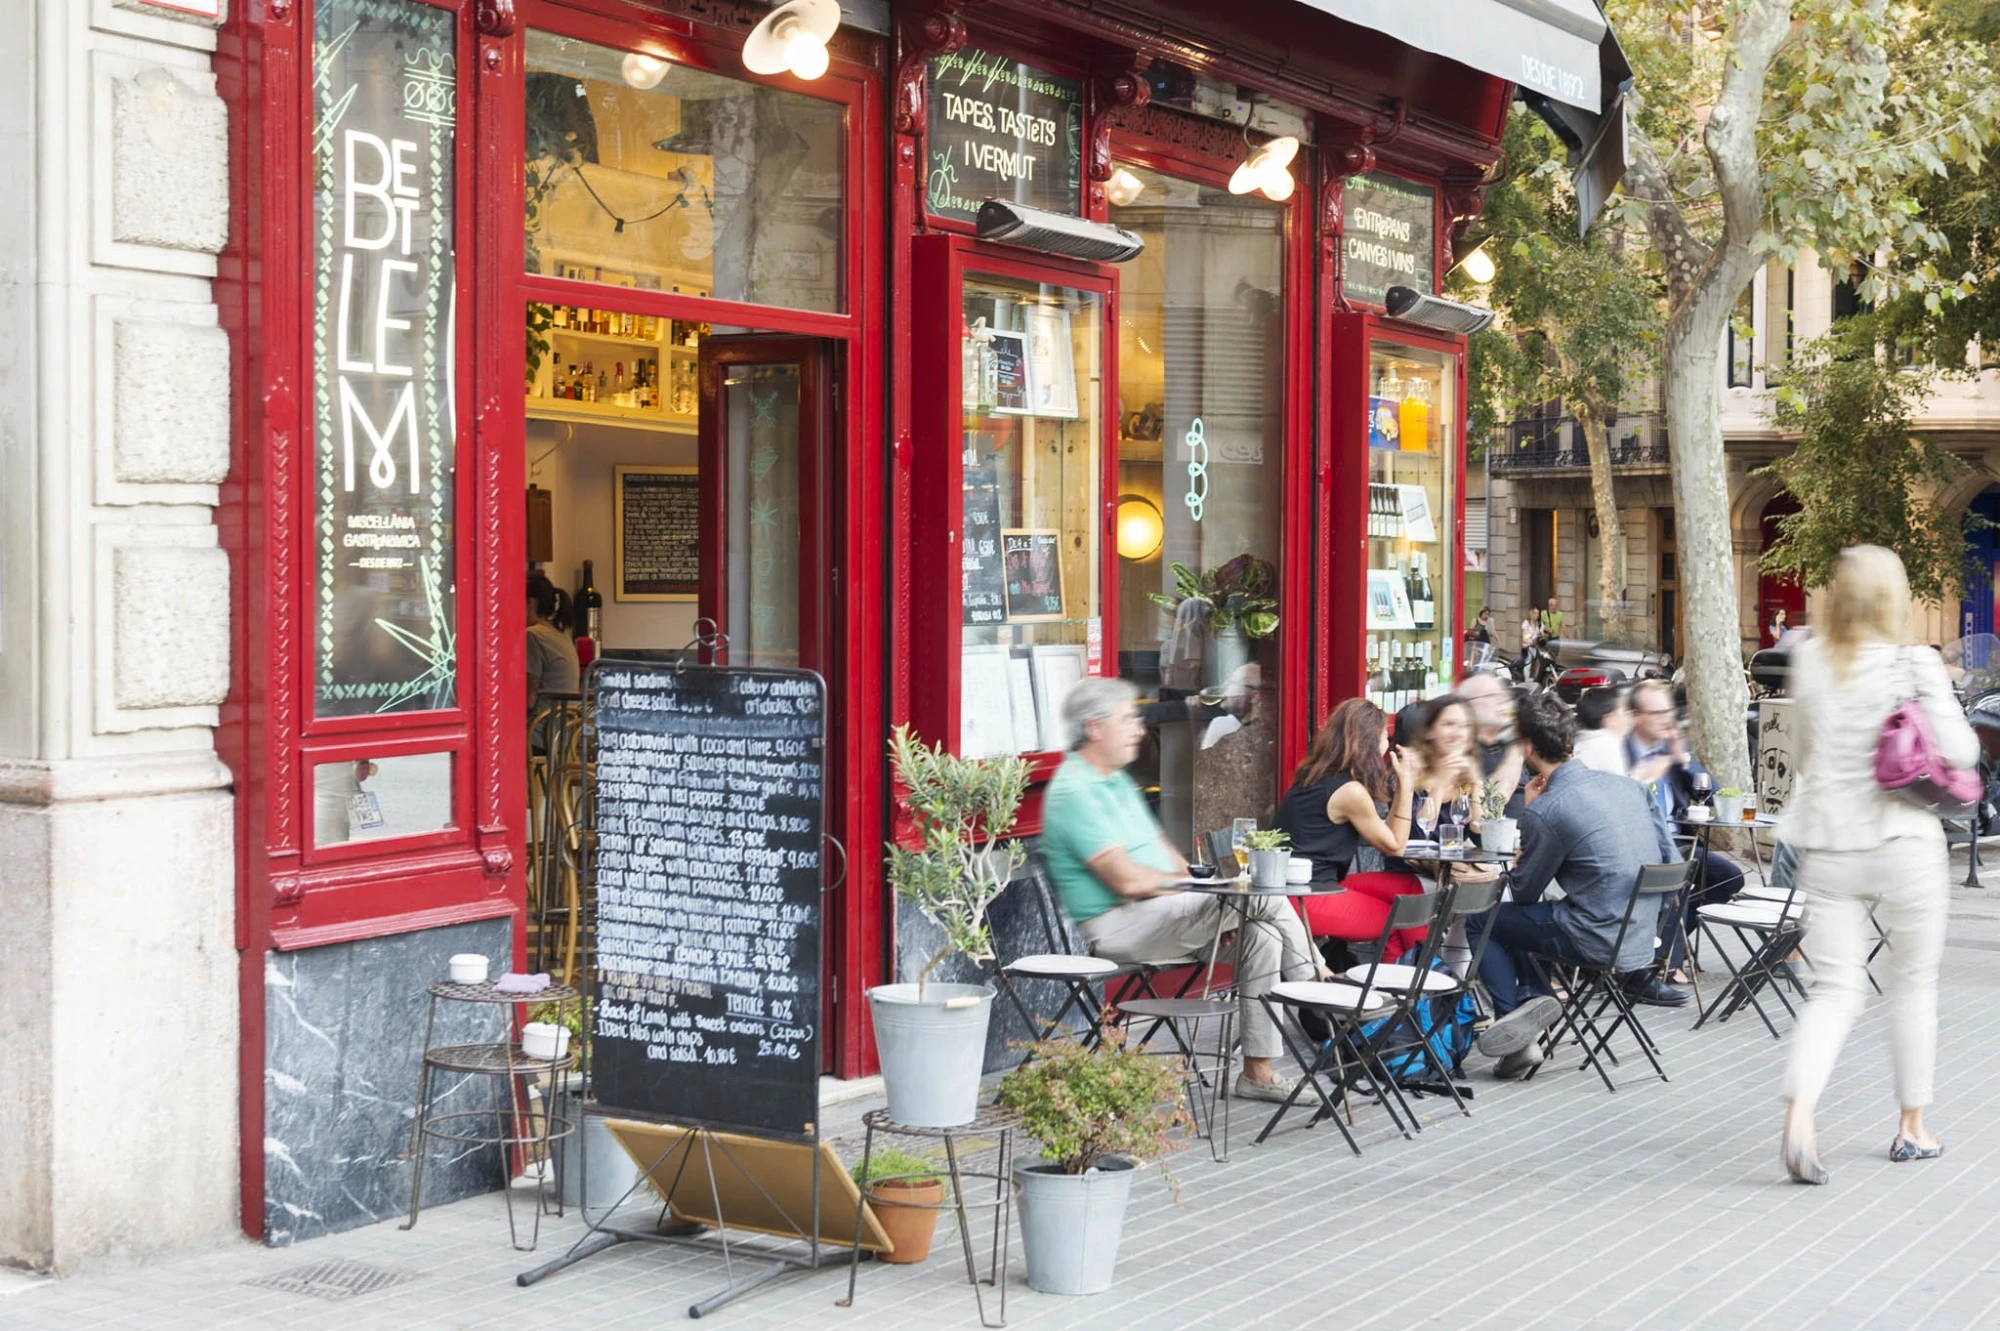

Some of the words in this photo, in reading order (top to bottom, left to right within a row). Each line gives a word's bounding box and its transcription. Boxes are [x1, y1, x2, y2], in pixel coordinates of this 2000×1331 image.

[942, 92, 996, 133] TAPES,
[971, 141, 1036, 181] VERMUT
[1348, 238, 1387, 267] CANYES
[1392, 249, 1415, 275] VINS
[727, 739, 746, 755] and
[727, 757, 745, 774] and
[725, 811, 746, 828] and
[770, 999, 793, 1020] 10%
[670, 1010, 692, 1028] with
[652, 1026, 675, 1045] with
[646, 1044, 667, 1060] and
